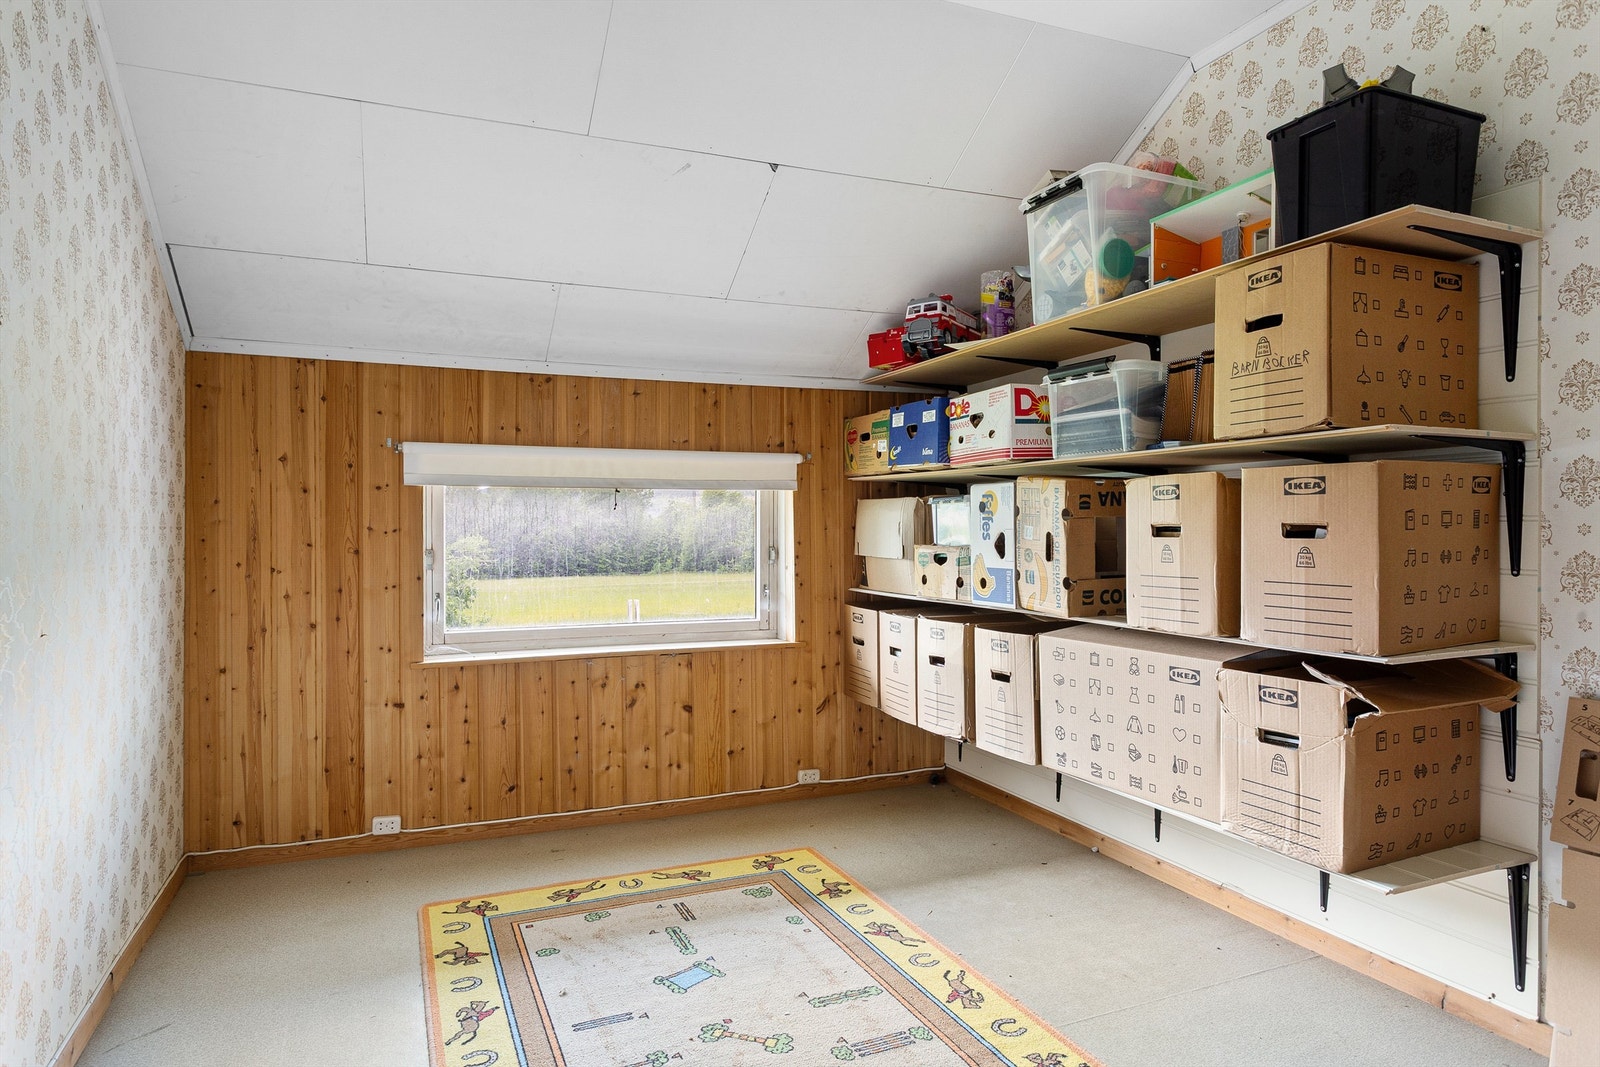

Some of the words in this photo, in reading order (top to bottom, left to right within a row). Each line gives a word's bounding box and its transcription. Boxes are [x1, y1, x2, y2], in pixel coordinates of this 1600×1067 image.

[1231, 359, 1260, 376] BARN
[949, 398, 971, 418] Dole
[1015, 438, 1049, 446] PREMIUM
[1098, 491, 1126, 507] NA
[1054, 541, 1060, 554] OF
[1100, 588, 1127, 606] CO
